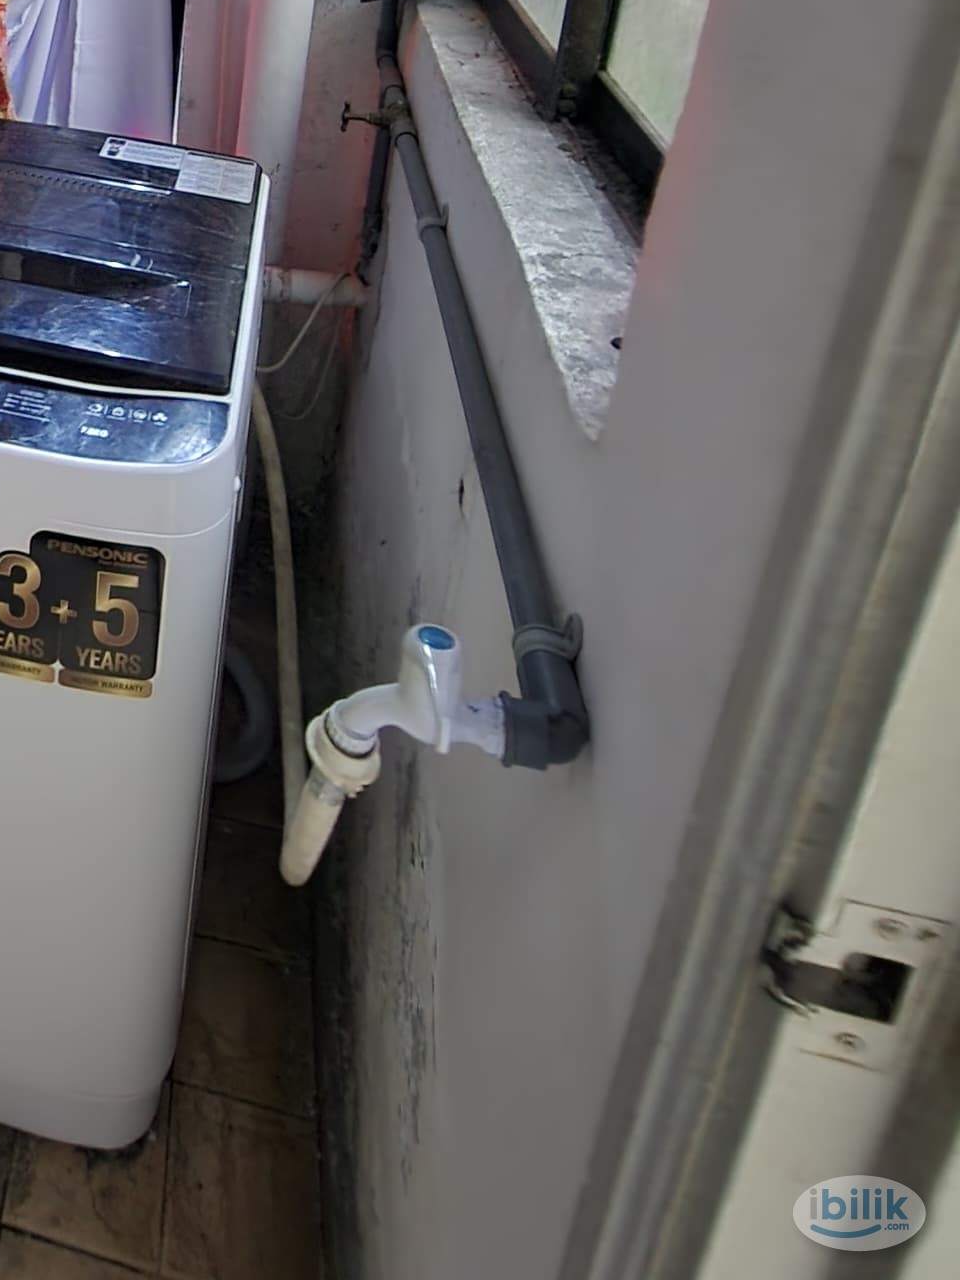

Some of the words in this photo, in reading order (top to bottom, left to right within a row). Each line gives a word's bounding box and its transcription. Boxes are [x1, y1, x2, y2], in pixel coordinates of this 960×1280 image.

[47, 538, 150, 565] PENSONIC
[92, 571, 140, 647] 5
[75, 646, 142, 674] YEARS
